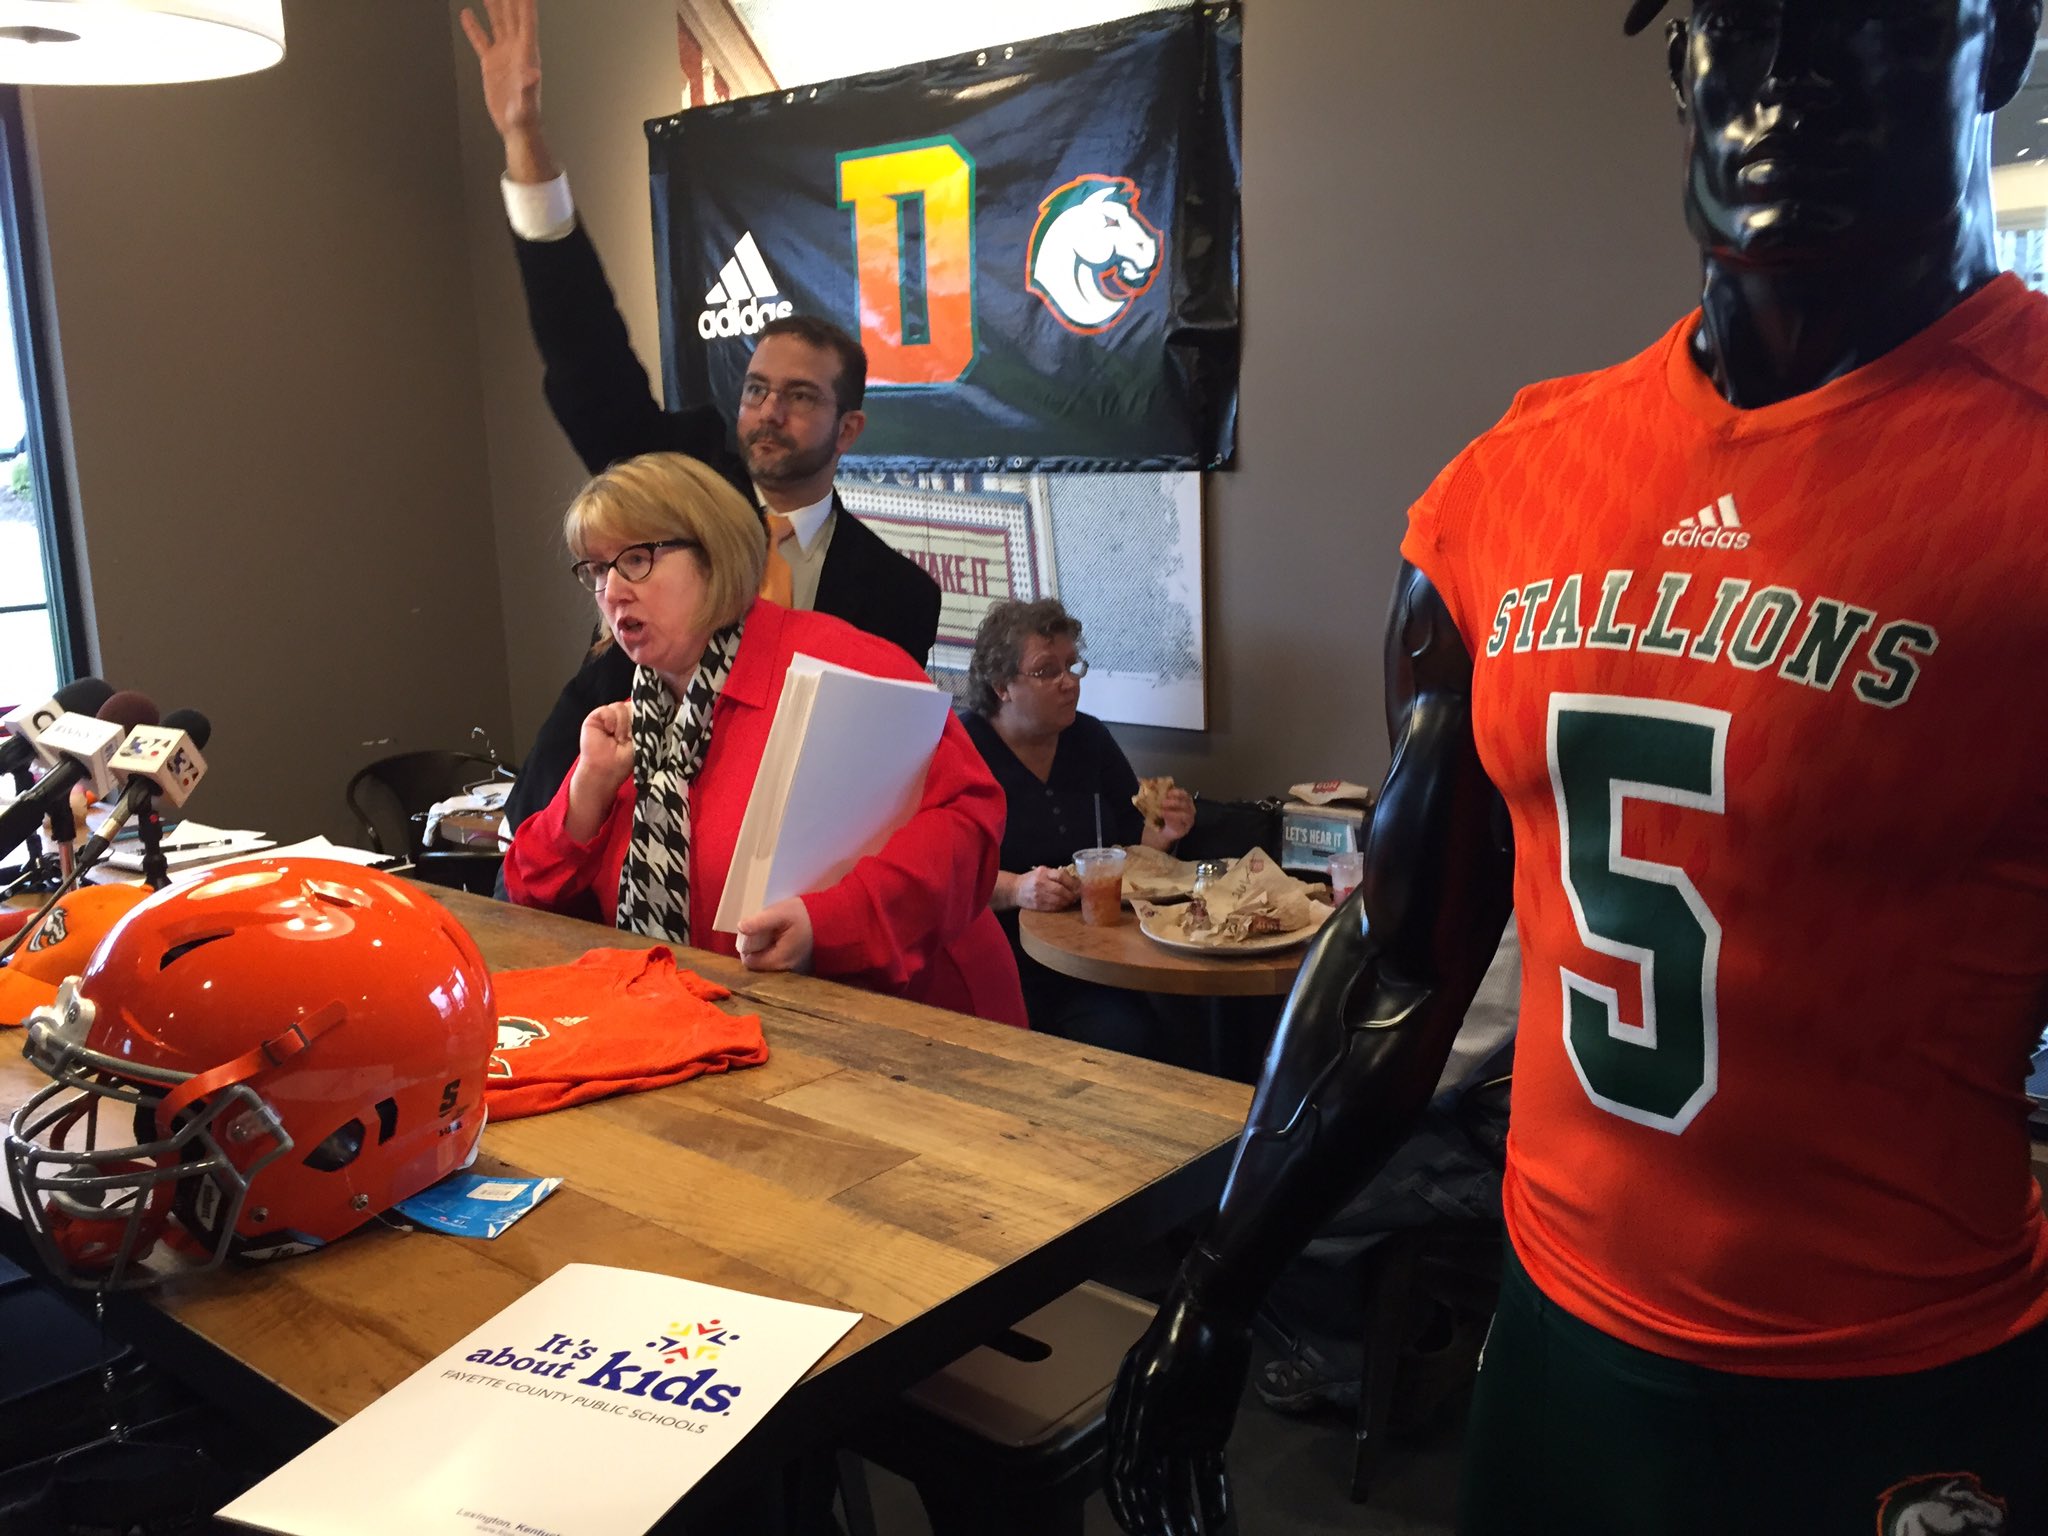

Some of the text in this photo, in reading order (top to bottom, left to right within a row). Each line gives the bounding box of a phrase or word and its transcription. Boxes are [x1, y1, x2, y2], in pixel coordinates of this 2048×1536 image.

[836, 134, 976, 392] D
[698, 296, 793, 340] adidas
[1661, 524, 1751, 550] adidas
[971, 556, 989, 597] IT
[1486, 569, 1940, 709] STALLIONS
[1285, 826, 1308, 843] LET'S
[1309, 829, 1332, 848] HEAR
[1333, 832, 1343, 848] IT
[1546, 692, 1732, 1136] 5
[465, 1347, 576, 1380] about
[535, 1333, 599, 1361] It's
[441, 1369, 709, 1435] FAYETTE COUNTY PUBLIC SCHOOLS
